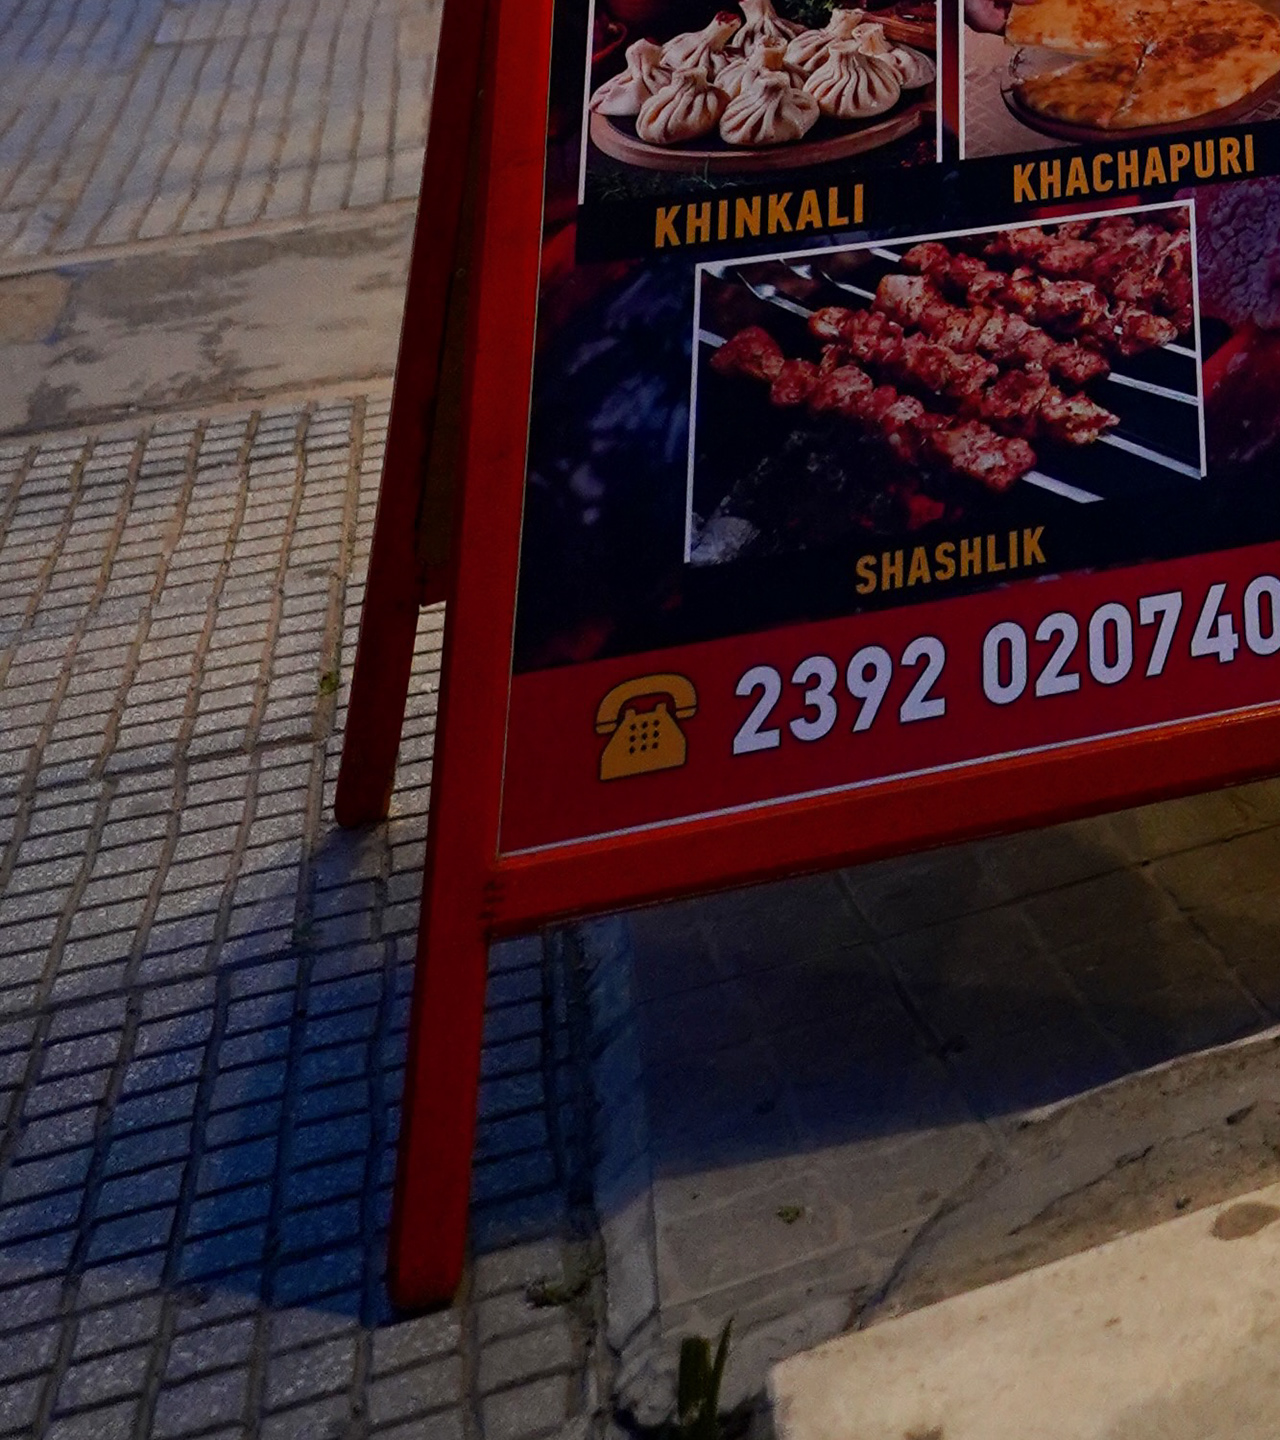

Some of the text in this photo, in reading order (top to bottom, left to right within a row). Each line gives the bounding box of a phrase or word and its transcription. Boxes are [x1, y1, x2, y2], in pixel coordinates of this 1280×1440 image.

[1013, 134, 1255, 203] KHACHAPURI
[655, 184, 864, 247] KHINKALI
[856, 527, 1046, 594] SHASHLIK
[733, 637, 946, 754] 2392
